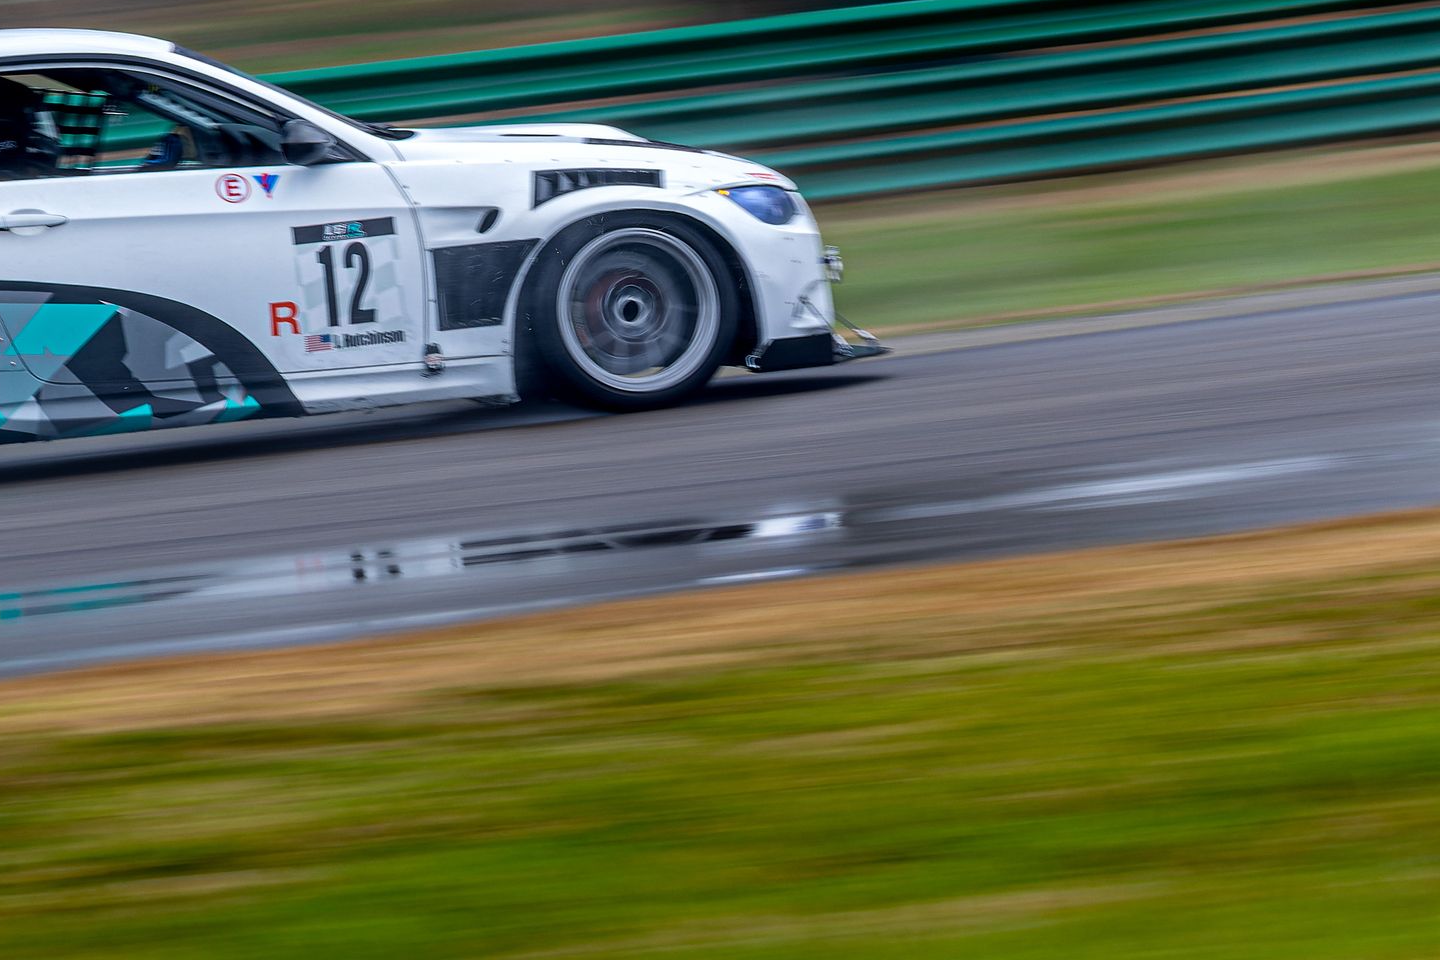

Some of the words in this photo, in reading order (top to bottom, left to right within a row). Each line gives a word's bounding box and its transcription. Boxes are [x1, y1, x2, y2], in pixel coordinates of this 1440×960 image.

[224, 179, 241, 197] E
[316, 241, 378, 327] 12
[268, 301, 301, 336] R
